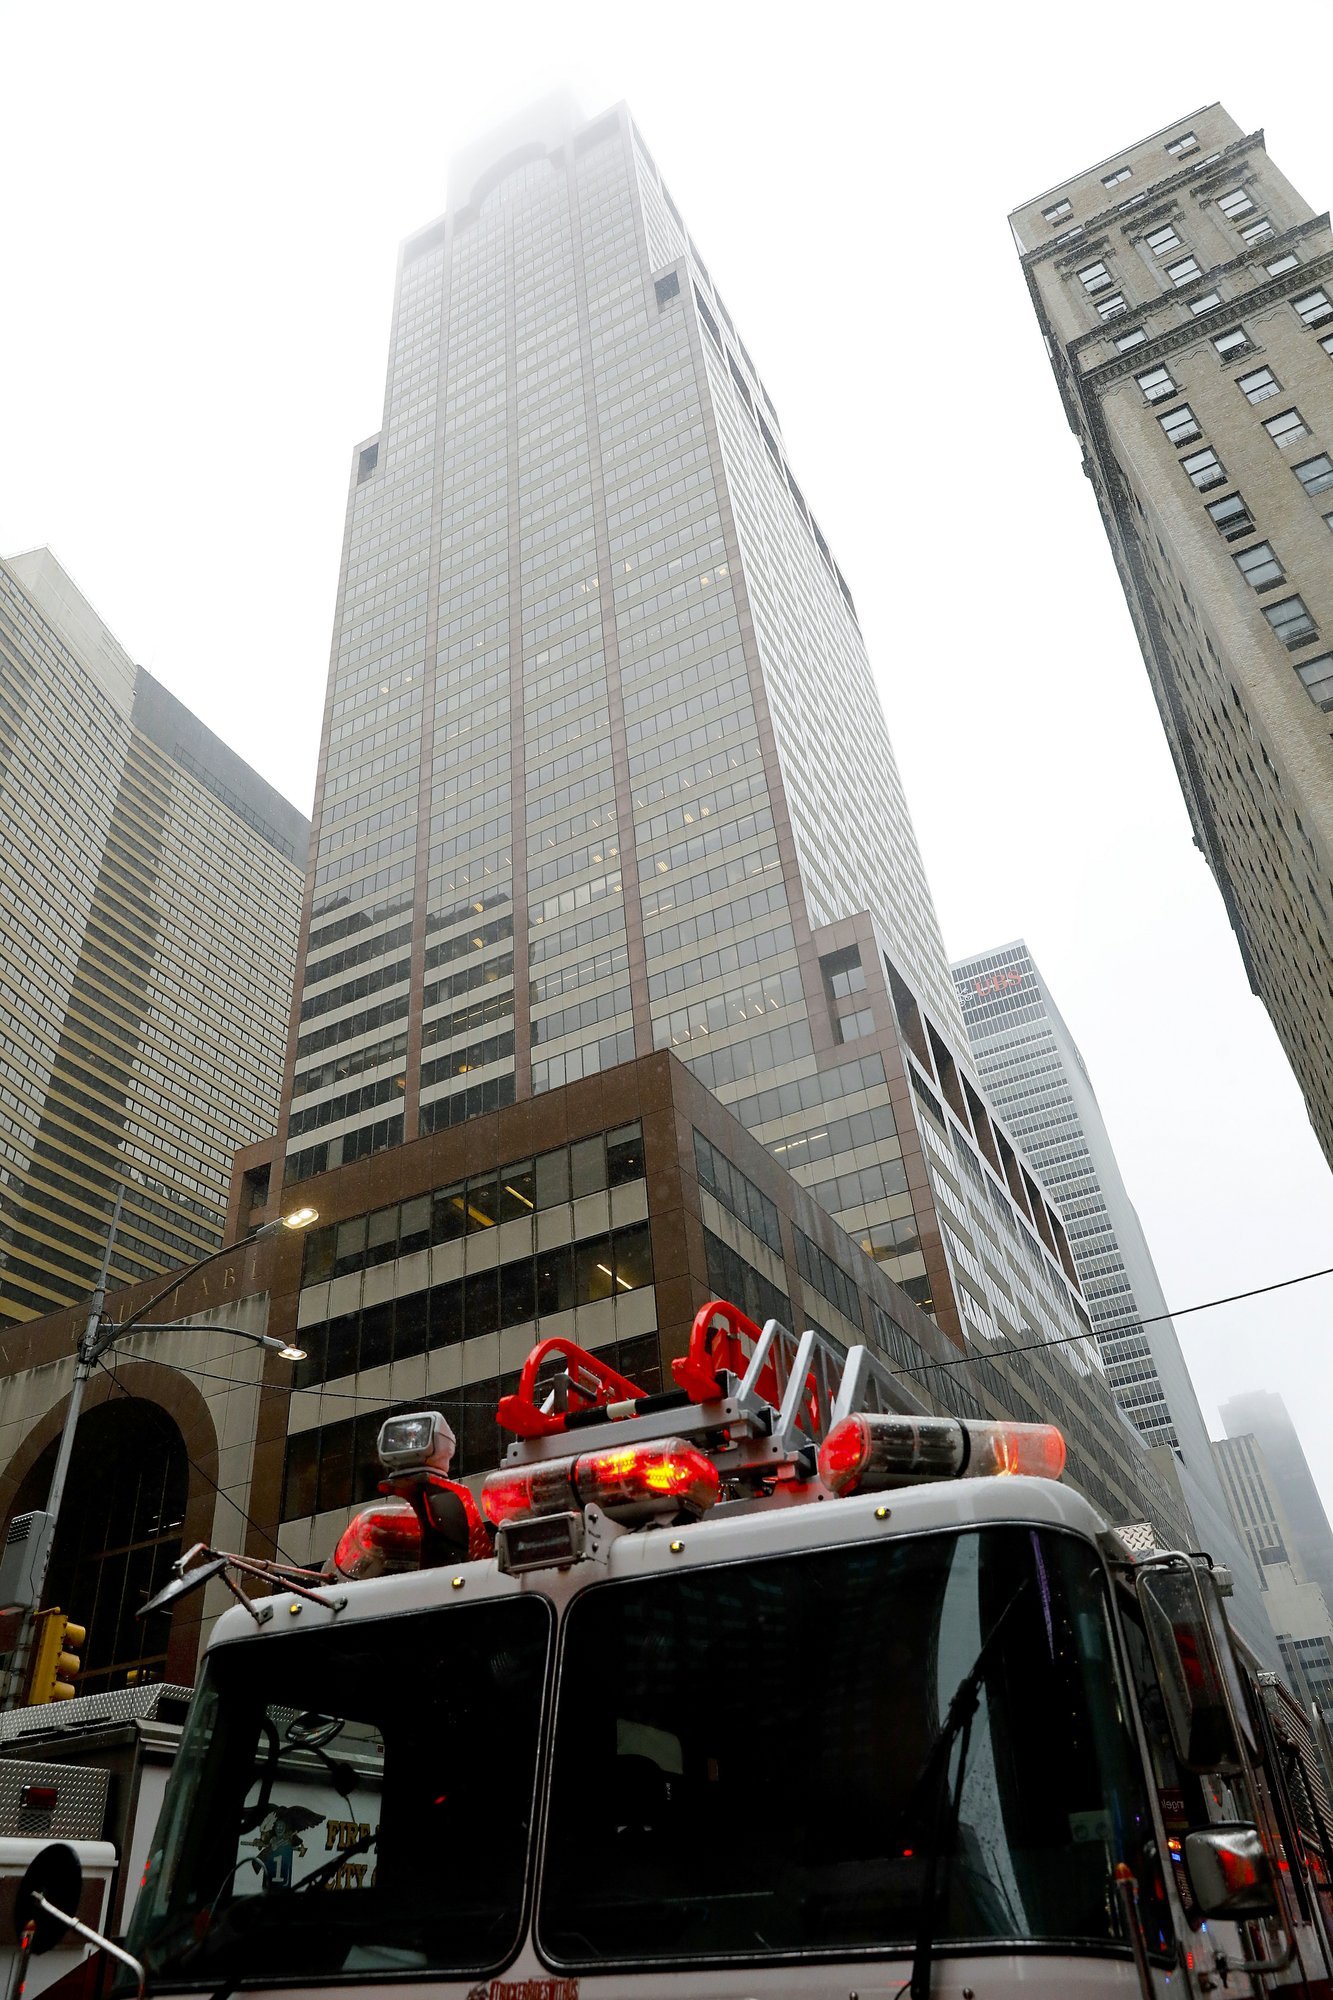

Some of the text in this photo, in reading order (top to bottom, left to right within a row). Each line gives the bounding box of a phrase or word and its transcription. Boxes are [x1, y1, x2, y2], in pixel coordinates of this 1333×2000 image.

[974, 969, 1022, 997] UBS
[325, 1820, 370, 1852] FIRE
[271, 1854, 284, 1882] 1
